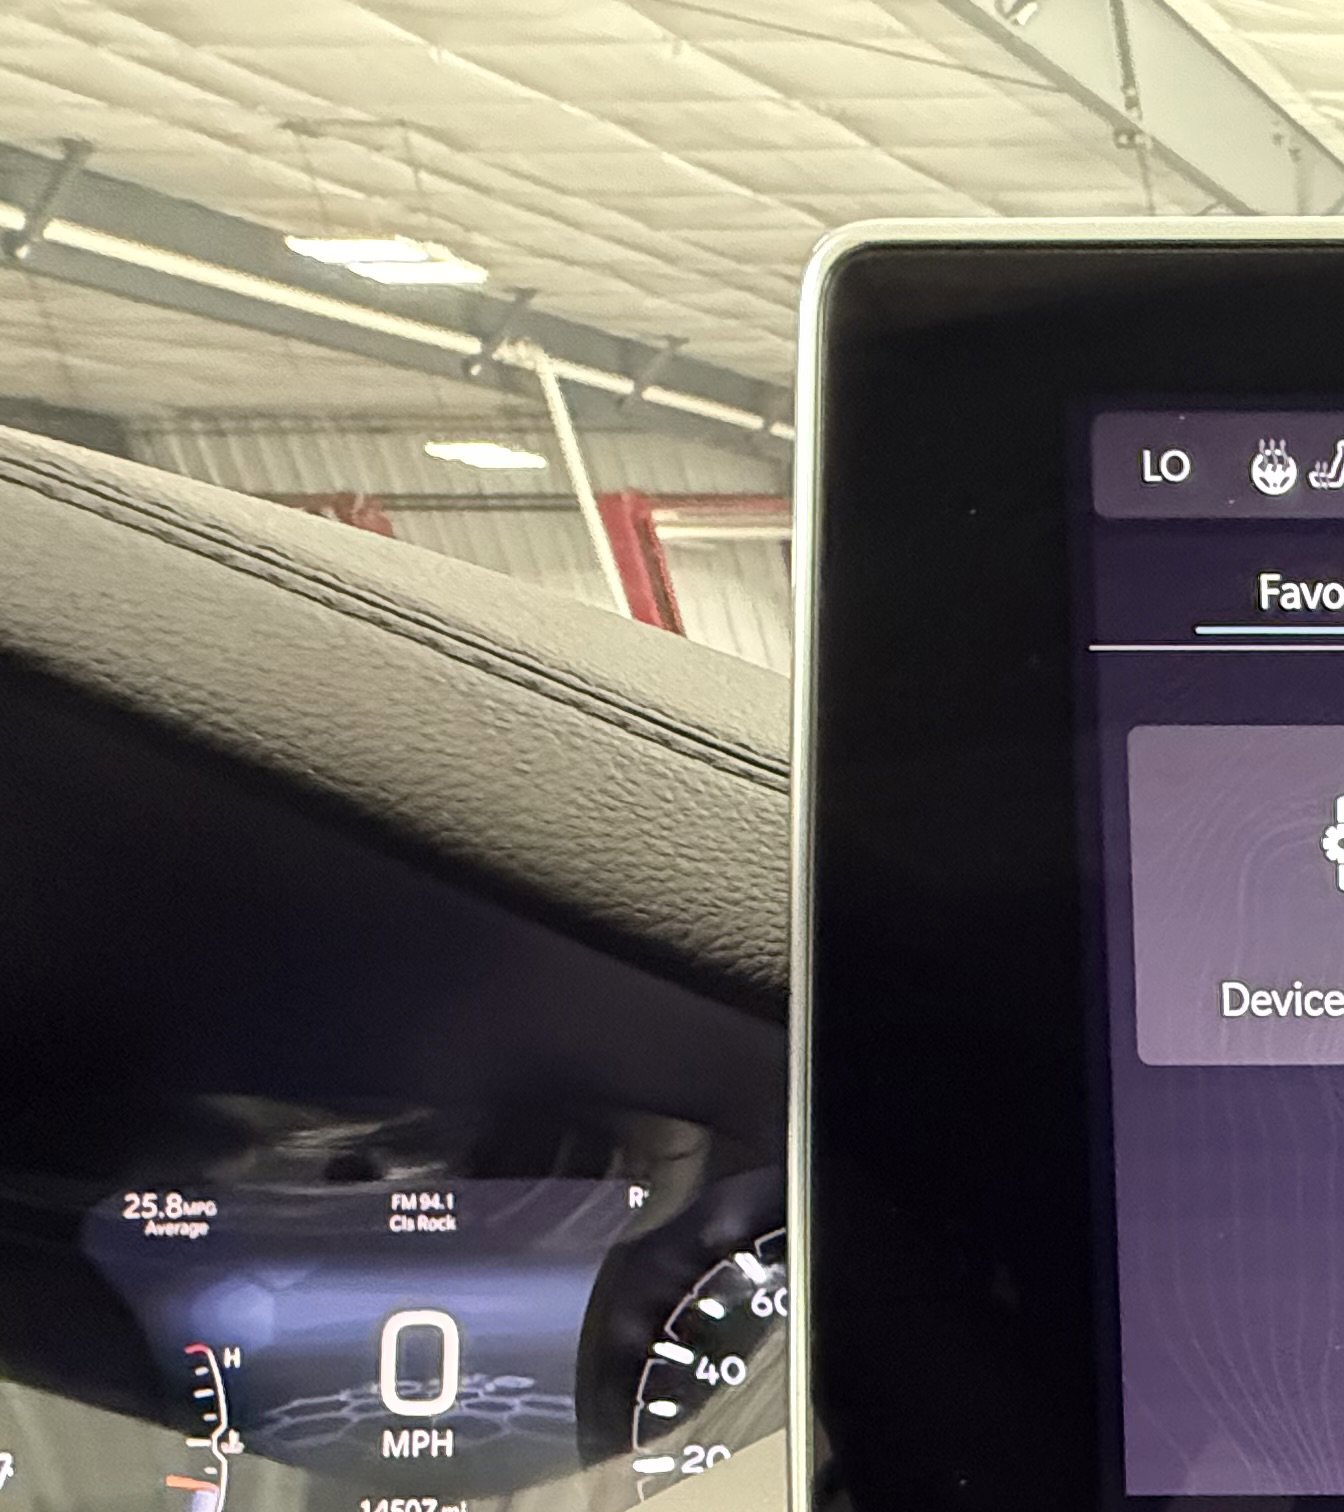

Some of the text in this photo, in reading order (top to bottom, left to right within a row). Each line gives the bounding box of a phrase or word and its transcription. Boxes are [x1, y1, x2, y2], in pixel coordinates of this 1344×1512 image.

[1143, 449, 1191, 482] LO
[391, 1192, 454, 1211] FM 94.1
[416, 1214, 457, 1232] Rock
[223, 1346, 241, 1369] H
[380, 1310, 460, 1416] 0
[695, 1355, 746, 1385] 40
[382, 1429, 454, 1459] MPH
